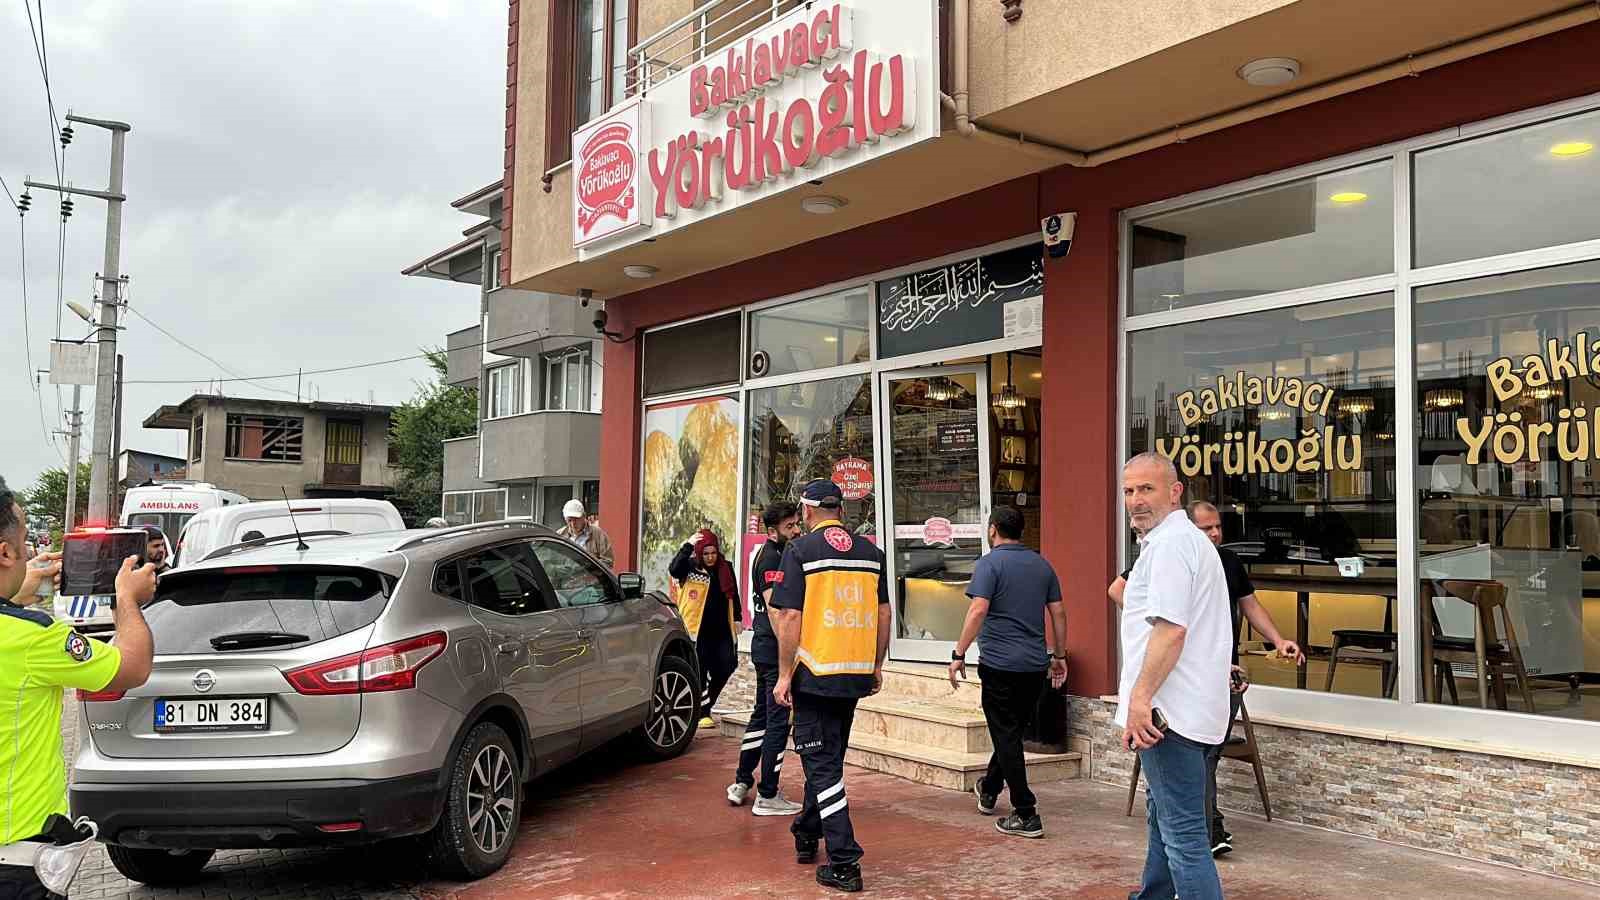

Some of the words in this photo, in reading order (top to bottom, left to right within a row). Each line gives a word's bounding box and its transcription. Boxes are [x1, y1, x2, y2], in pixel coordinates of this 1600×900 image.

[690, 3, 840, 118] Baklavacı
[649, 49, 904, 218] Yörükoğlu
[590, 150, 619, 171] Baklavacı
[581, 161, 630, 197] Yörükoğlu
[1176, 371, 1334, 427] Baklavacı
[140, 502, 199, 510] AMBULANS
[166, 704, 184, 723] 81
[197, 703, 218, 722] DN
[230, 702, 262, 722] 384
